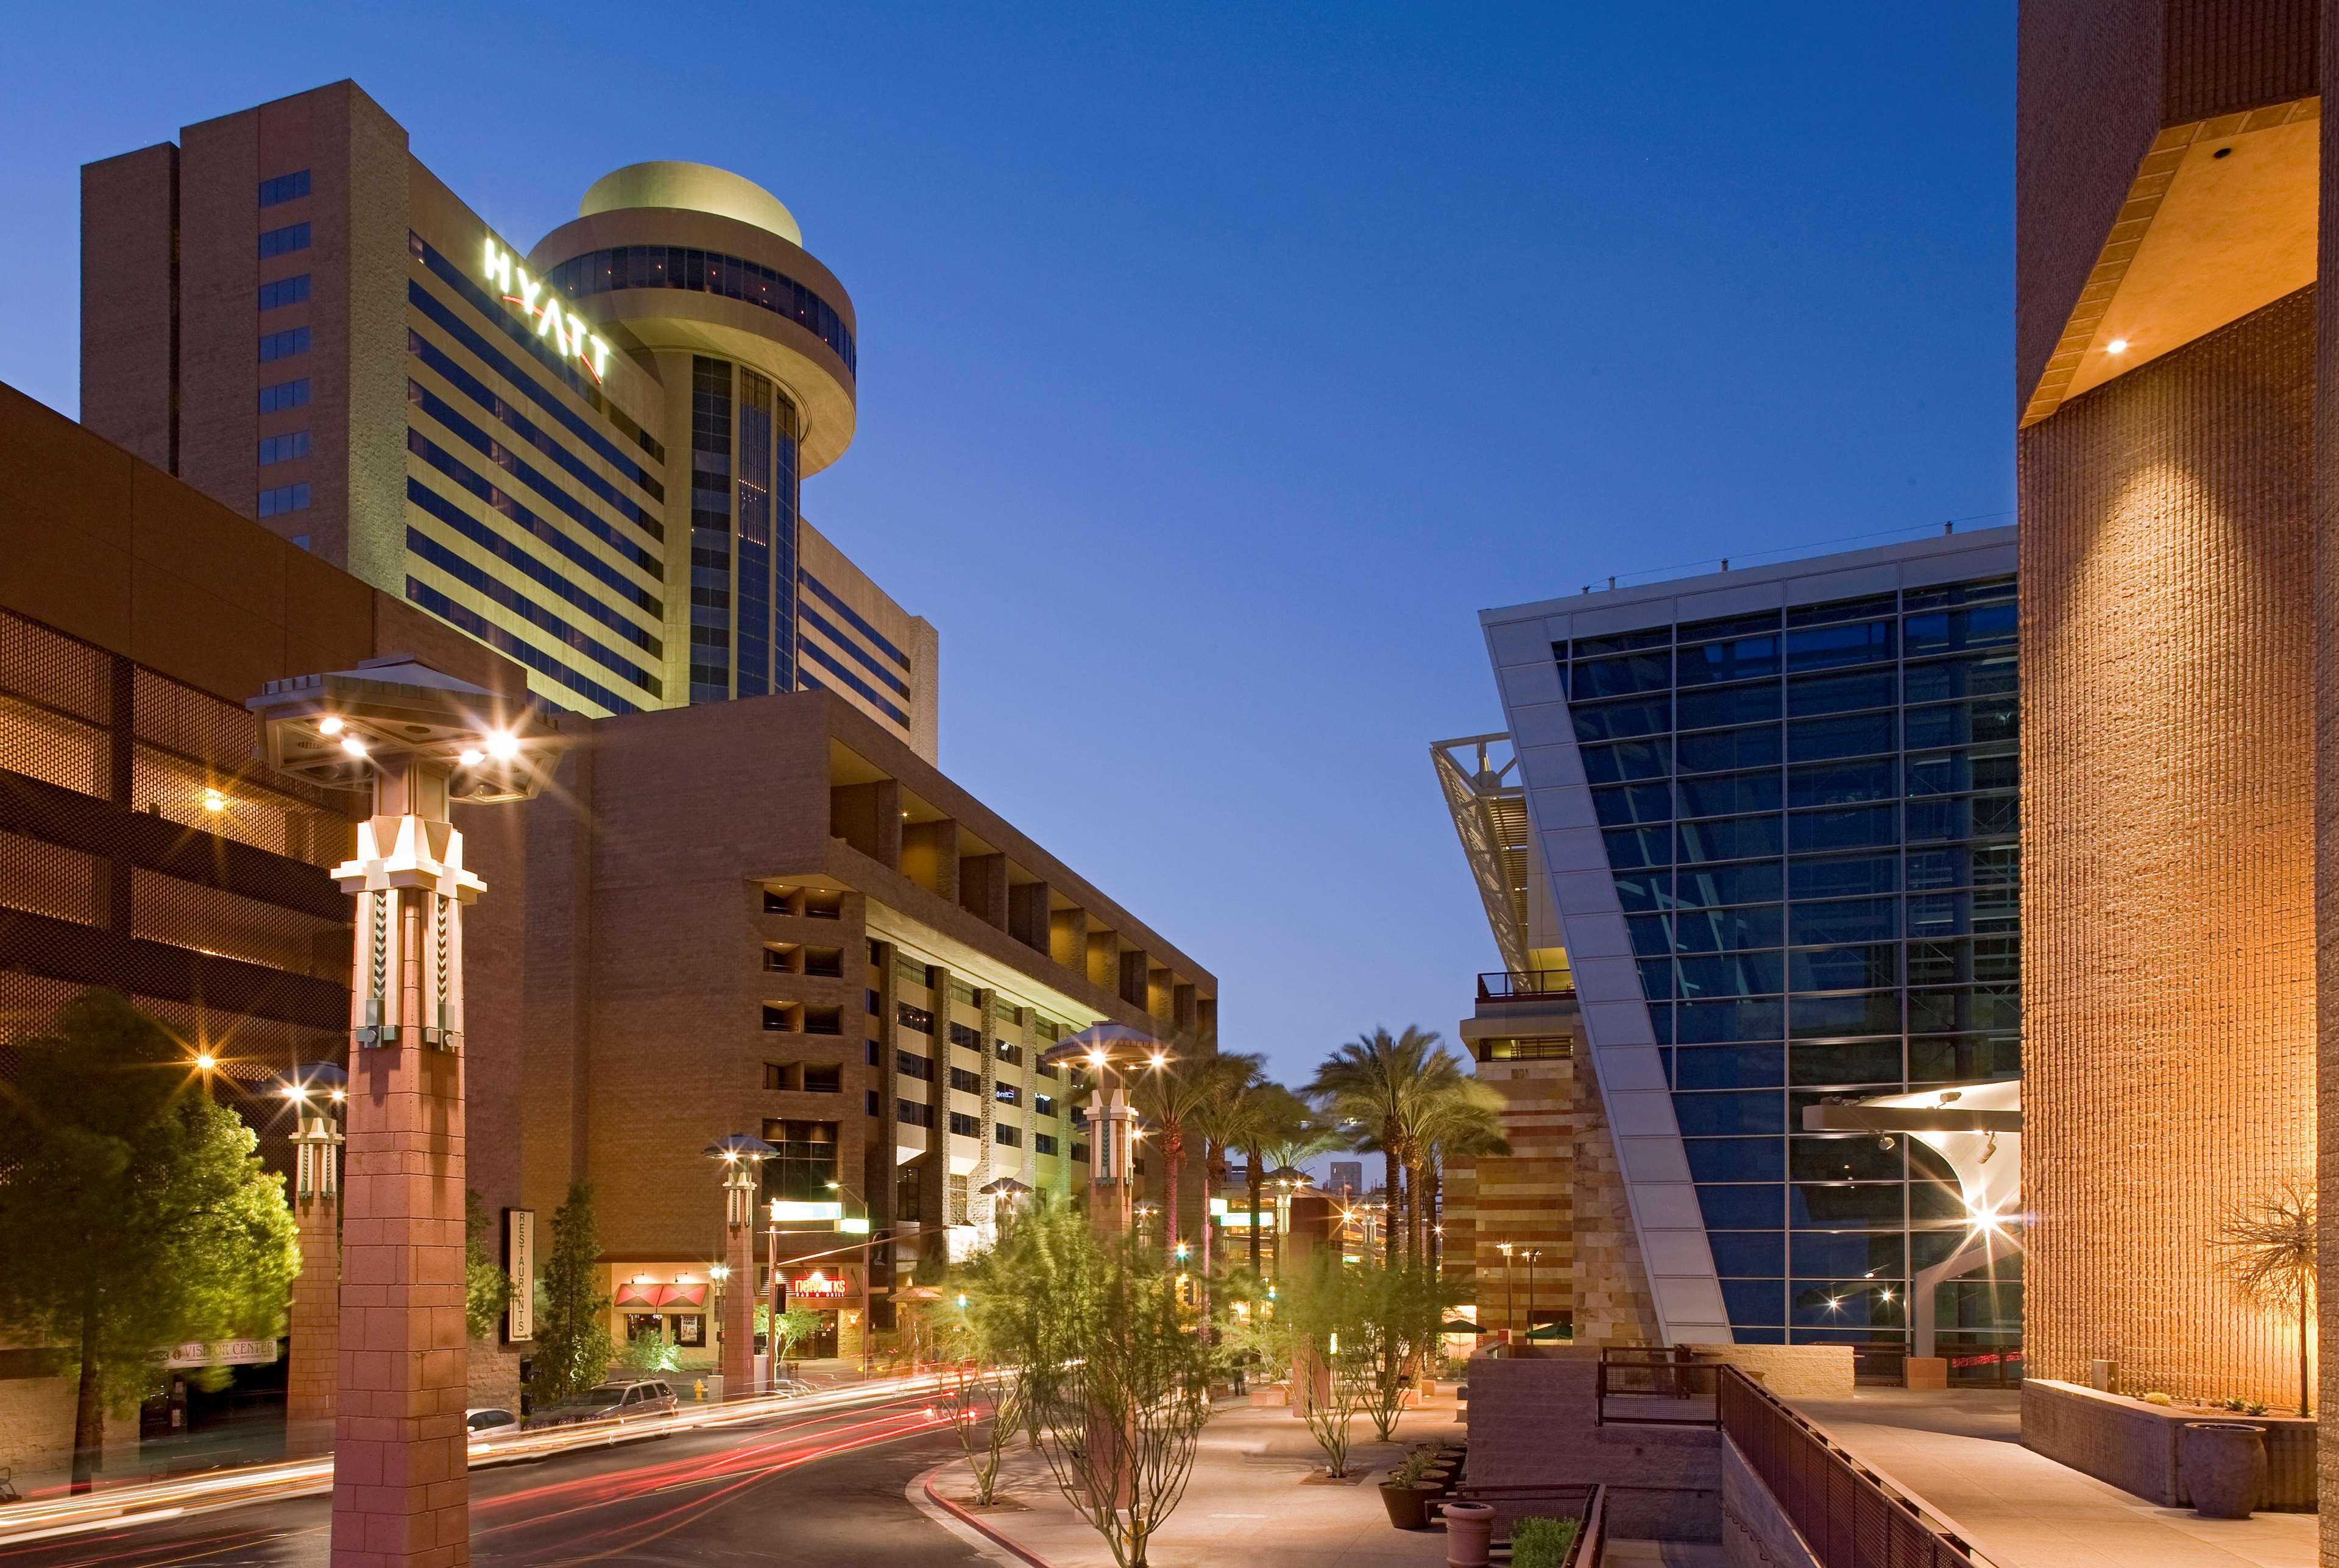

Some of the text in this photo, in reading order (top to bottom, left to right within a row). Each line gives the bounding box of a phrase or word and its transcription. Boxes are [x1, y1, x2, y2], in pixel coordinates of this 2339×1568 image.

[484, 238, 610, 378] HYATT
[185, 1344, 229, 1358] VISIOR
[233, 1341, 273, 1355] CENTER
